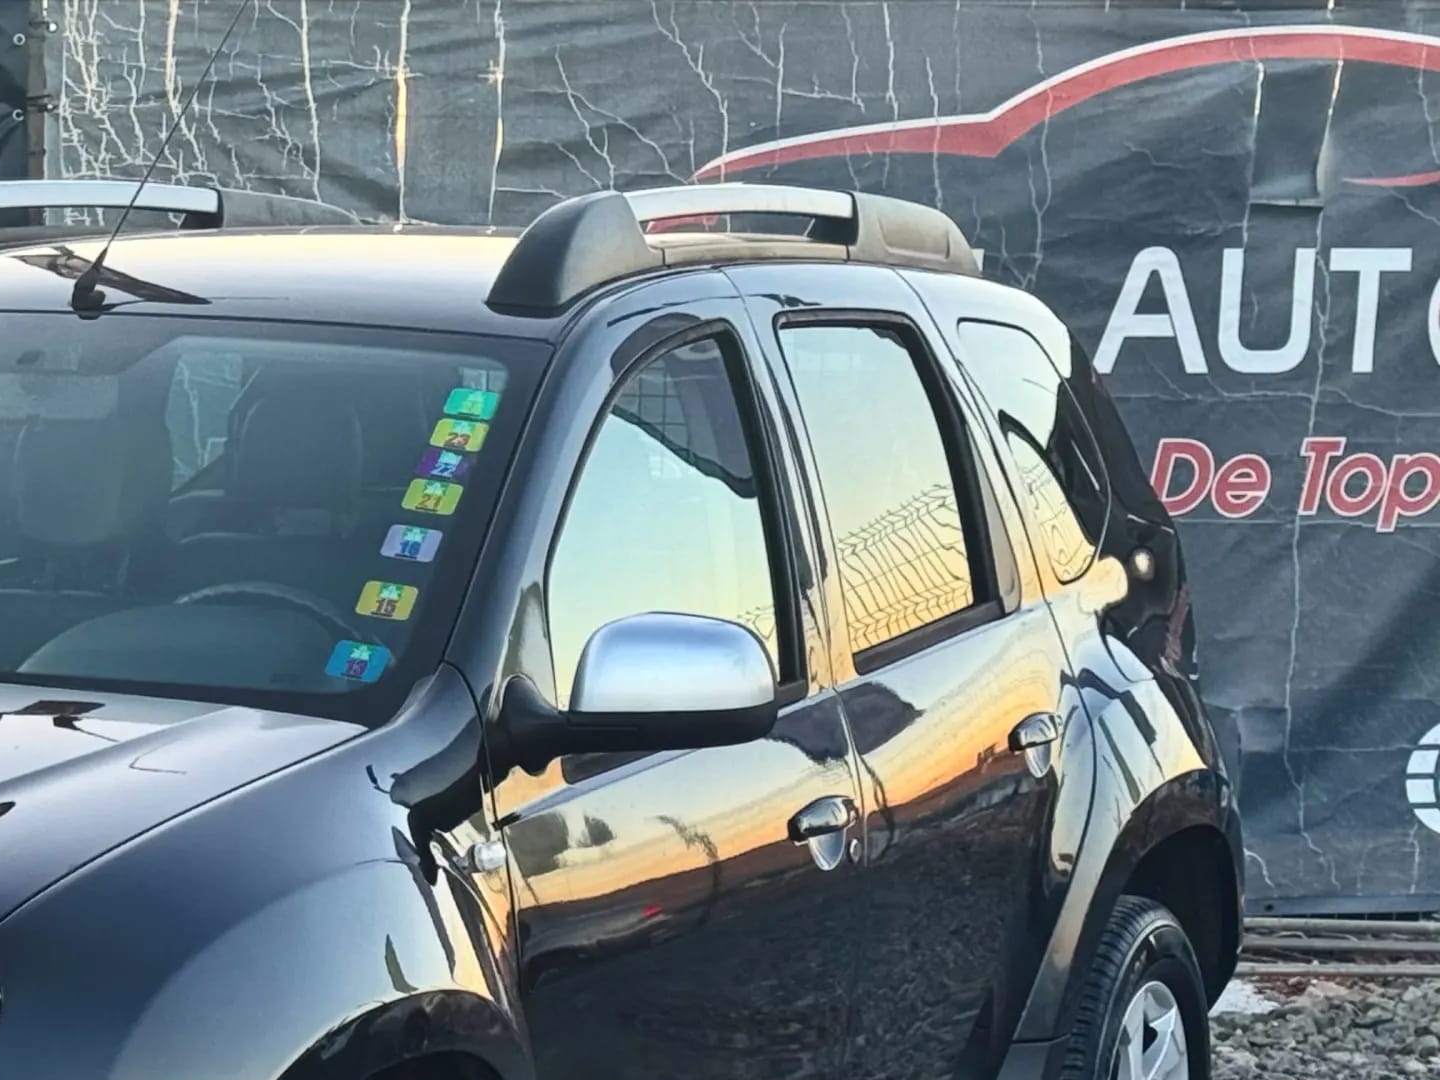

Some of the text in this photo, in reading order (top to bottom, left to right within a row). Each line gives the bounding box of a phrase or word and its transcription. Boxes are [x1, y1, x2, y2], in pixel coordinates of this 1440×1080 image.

[1092, 246, 1440, 374] AUT
[1150, 437, 1440, 532] De Top
